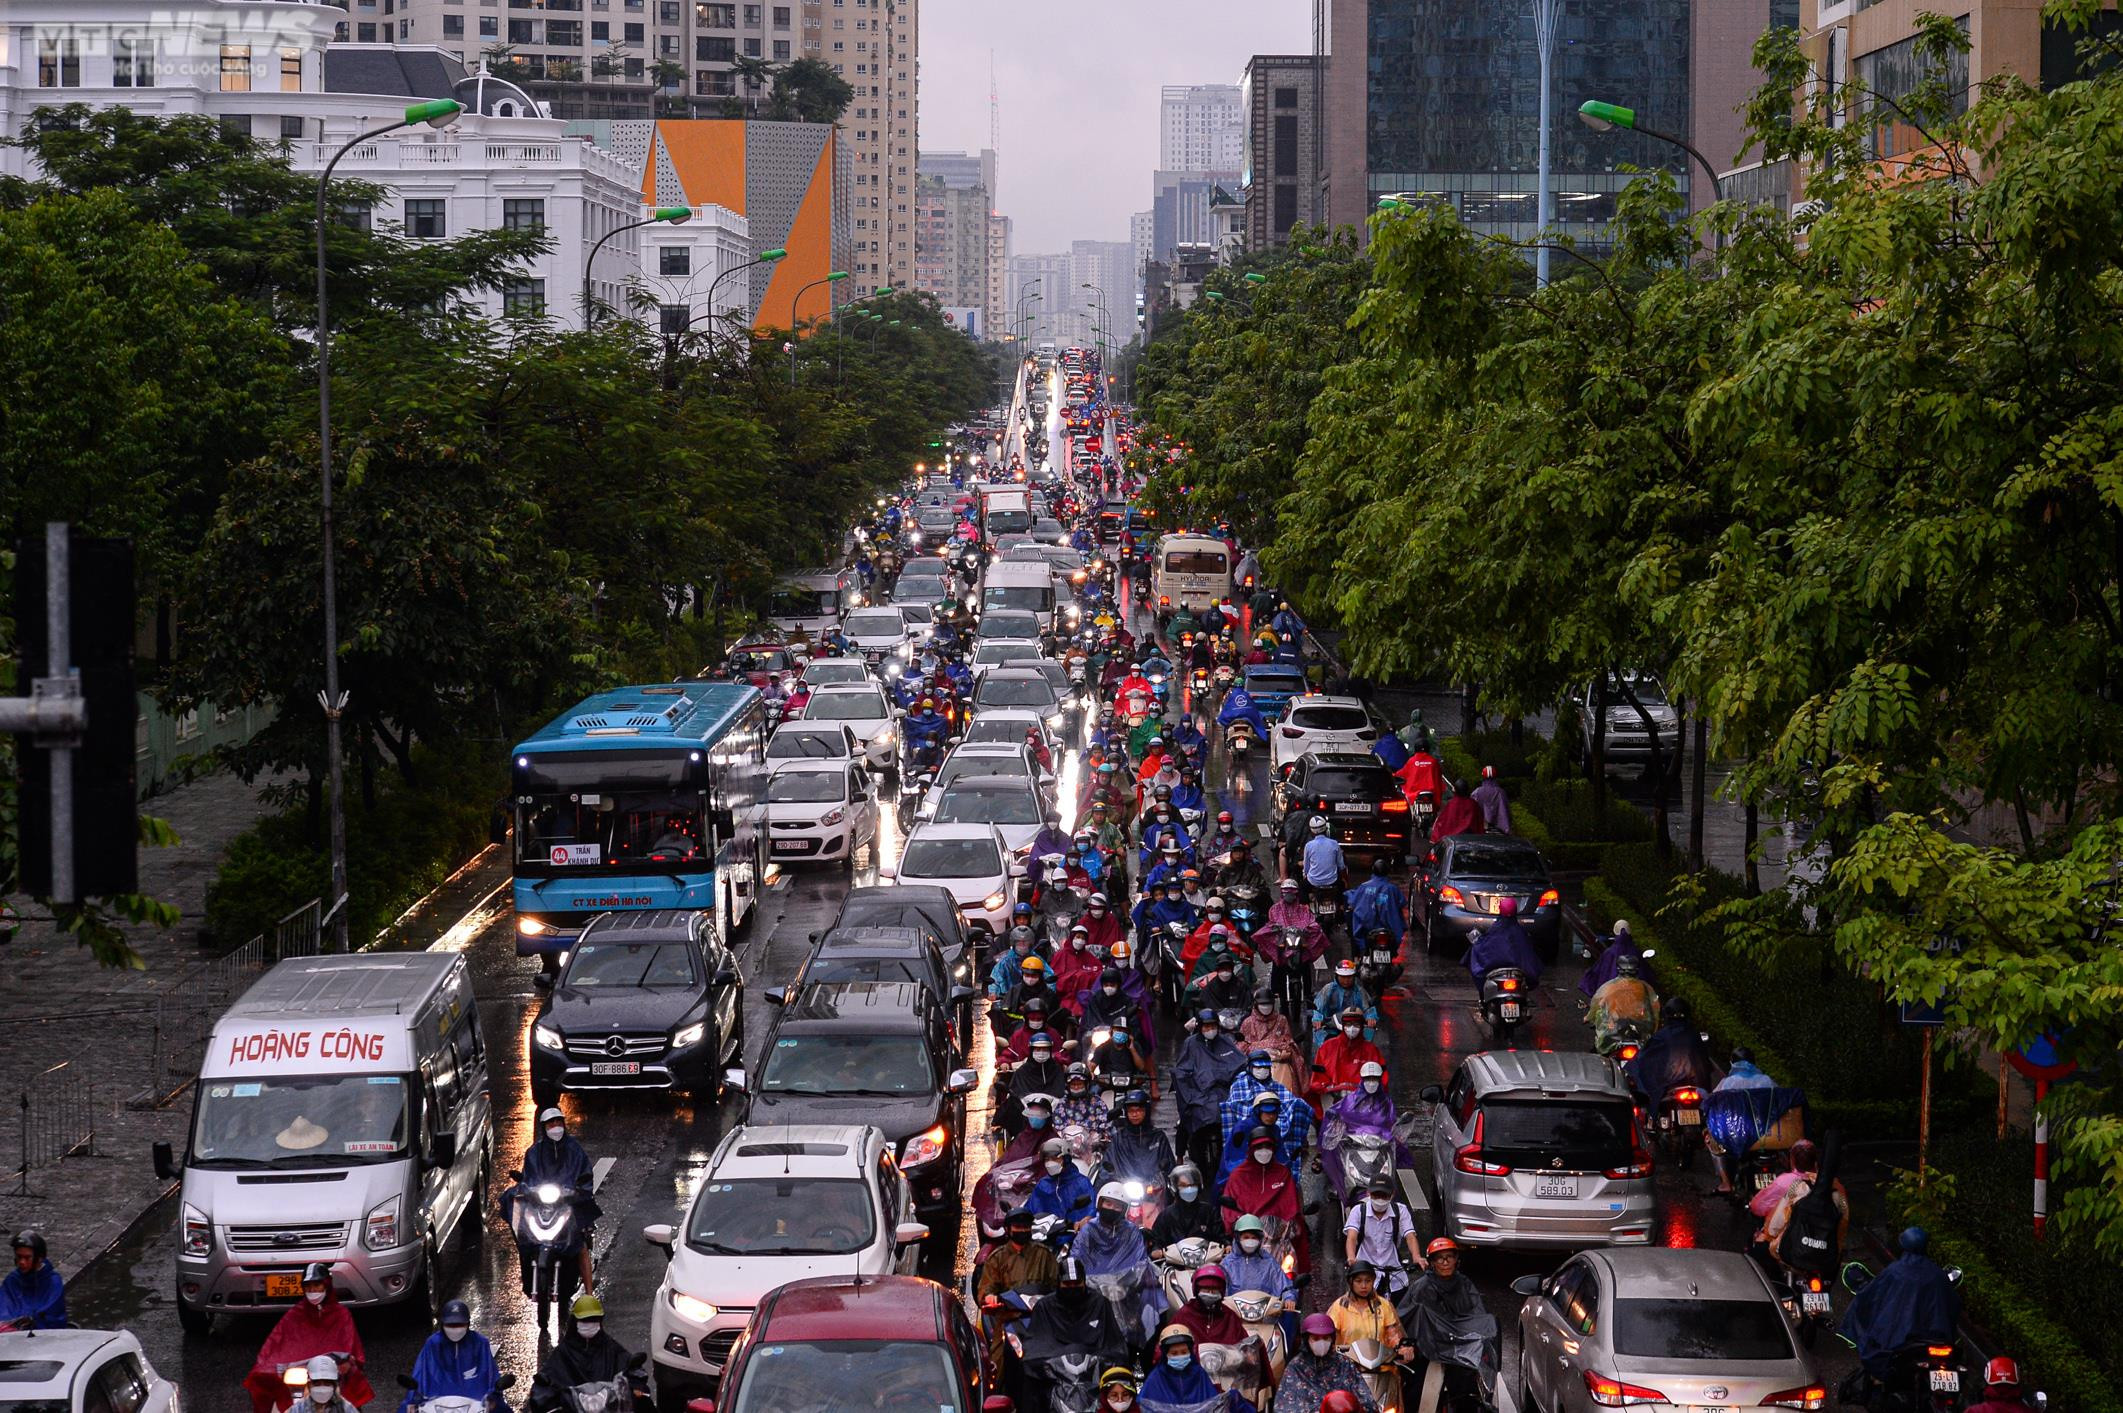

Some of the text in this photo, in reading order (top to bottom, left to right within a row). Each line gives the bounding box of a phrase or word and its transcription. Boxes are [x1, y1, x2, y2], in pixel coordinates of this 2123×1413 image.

[554, 850, 566, 861] 44
[586, 898, 597, 907] XE
[229, 1027, 385, 1067] HOÀNG CÔNG
[1548, 1176, 1566, 1185] 30G
[1540, 1186, 1573, 1196] 589.03
